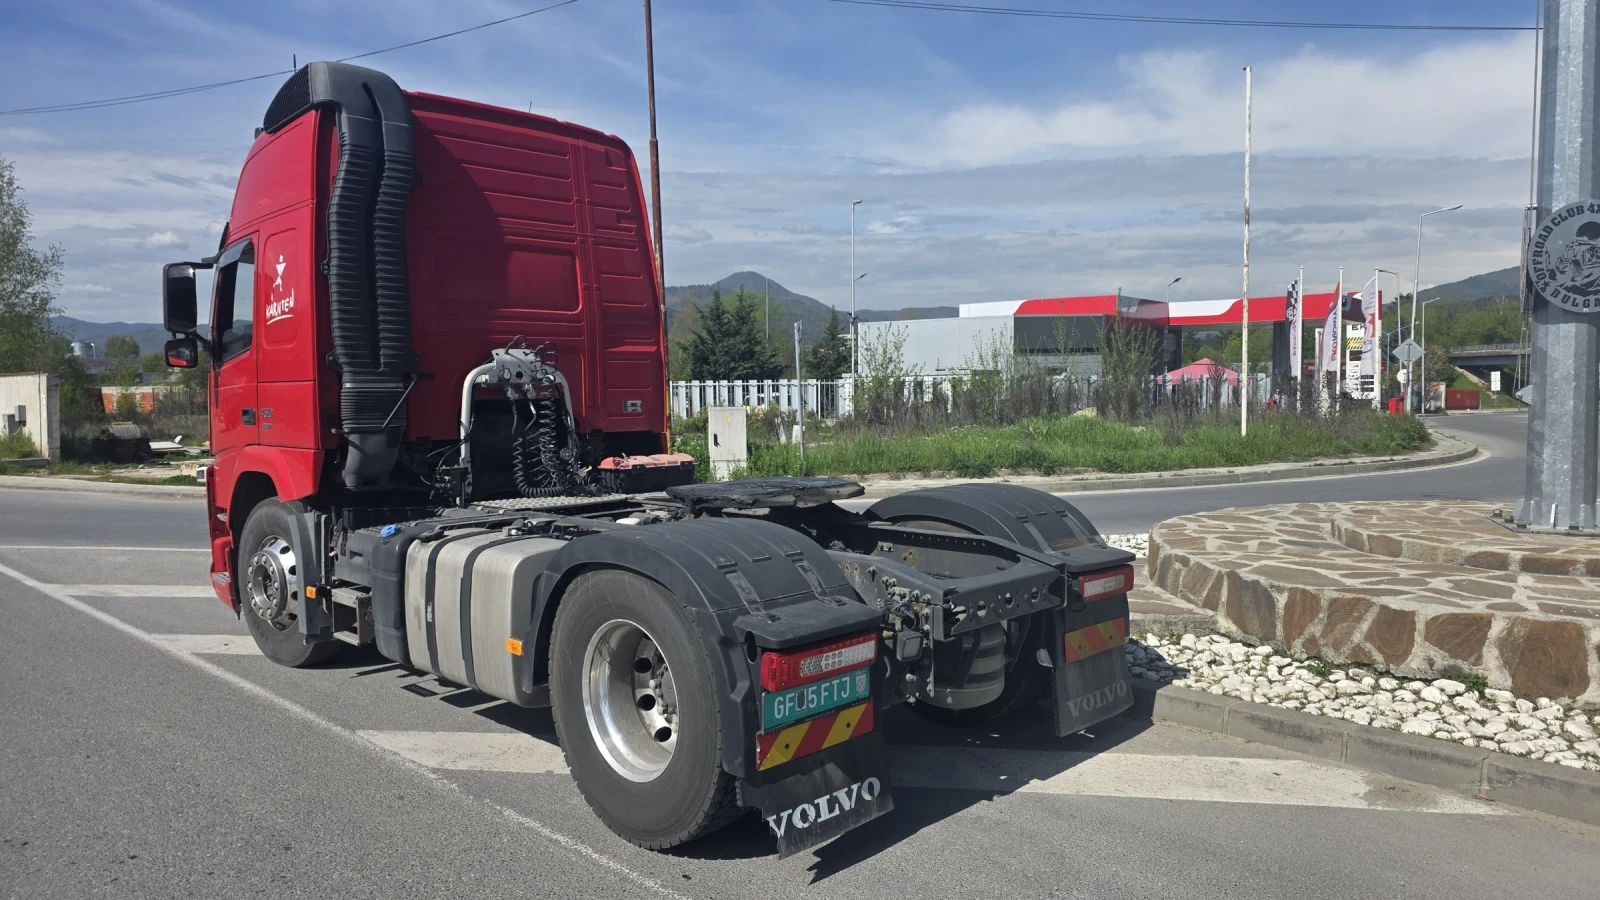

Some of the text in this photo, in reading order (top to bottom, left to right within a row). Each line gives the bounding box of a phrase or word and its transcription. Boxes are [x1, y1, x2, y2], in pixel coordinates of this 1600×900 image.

[1532, 225, 1554, 280] OFFROAD
[1550, 204, 1585, 227] CLUB
[774, 692, 795, 719] GF
[1066, 680, 1127, 718] VOLVO
[766, 776, 881, 839] VOLVO
